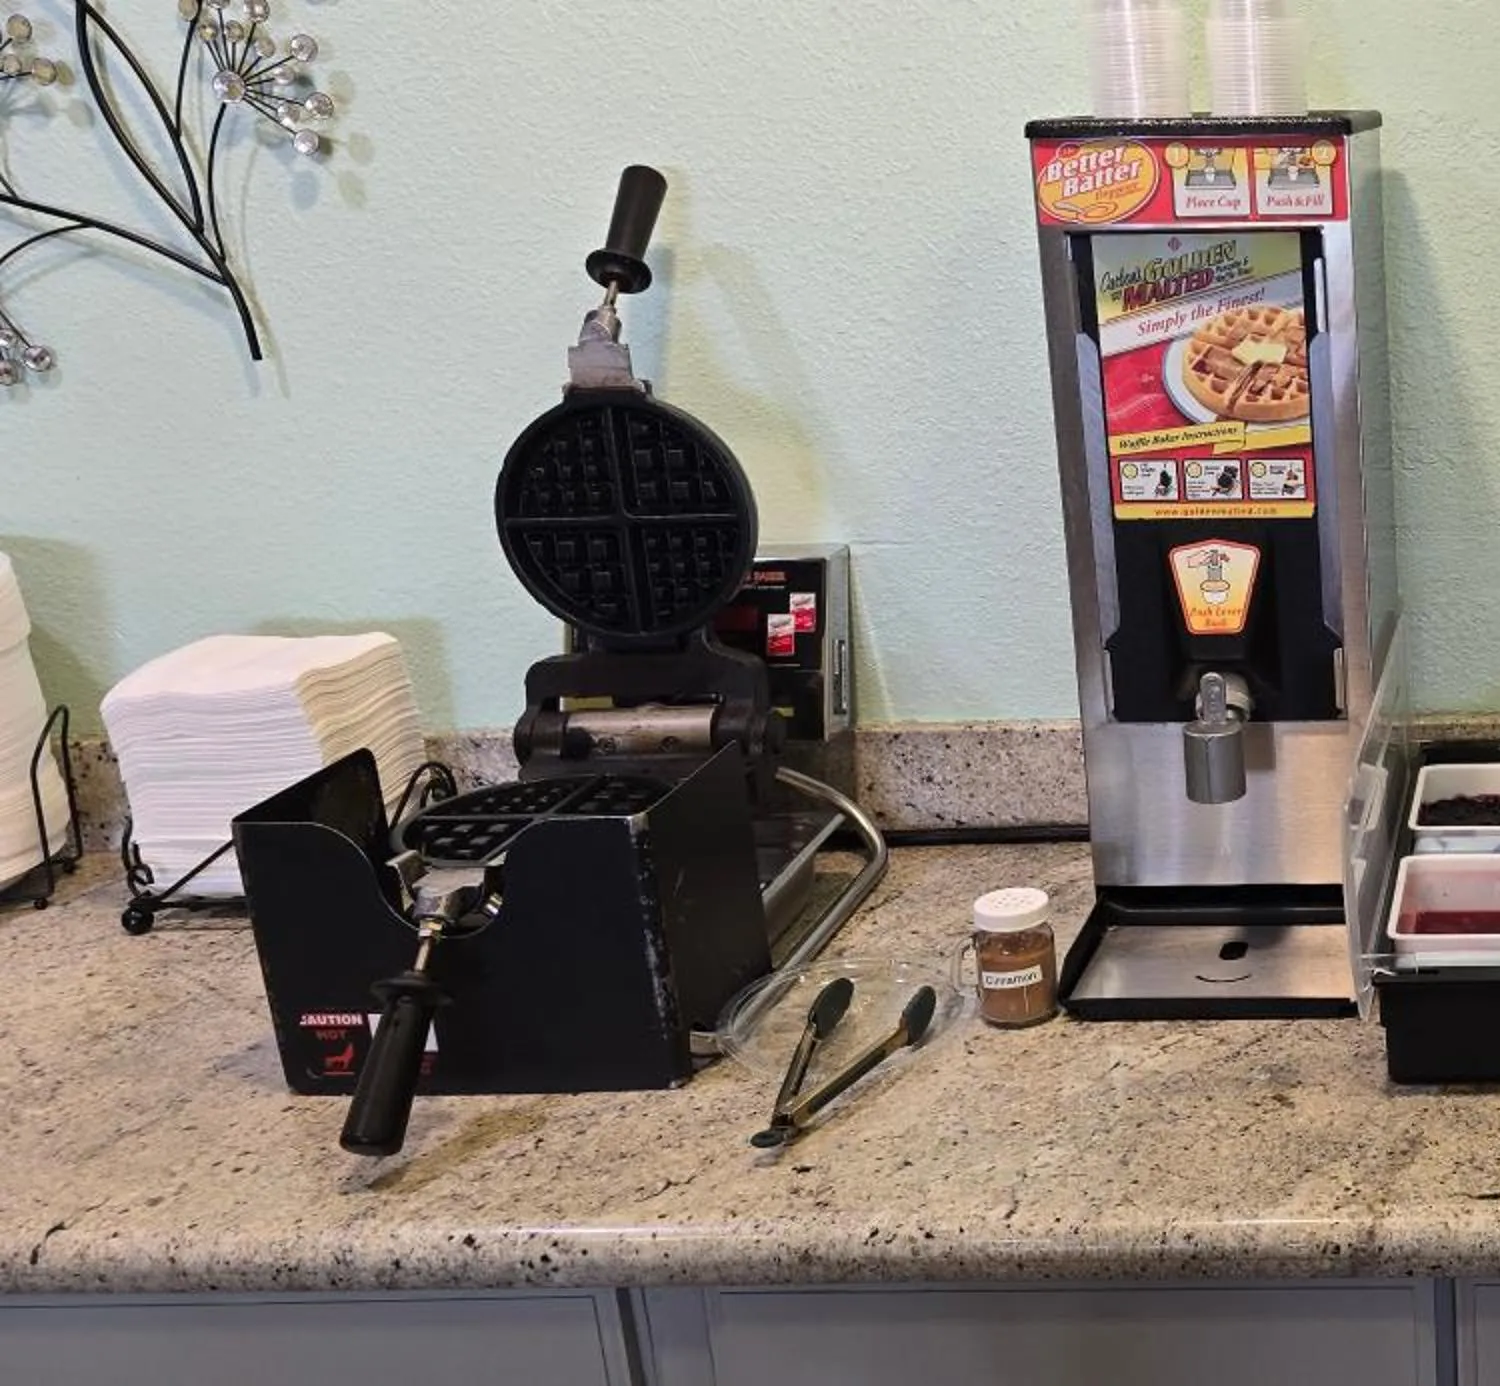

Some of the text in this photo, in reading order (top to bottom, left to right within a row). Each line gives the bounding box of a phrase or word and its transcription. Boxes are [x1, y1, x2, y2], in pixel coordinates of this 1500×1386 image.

[1045, 146, 1125, 183] Better
[1062, 160, 1141, 198] Batter
[1217, 194, 1242, 210] Cup
[1142, 239, 1238, 282] GOLDEN
[1121, 266, 1215, 313] MALTED
[1137, 287, 1266, 337] Simply the Finest!
[984, 970, 1039, 986] Cinnamon
